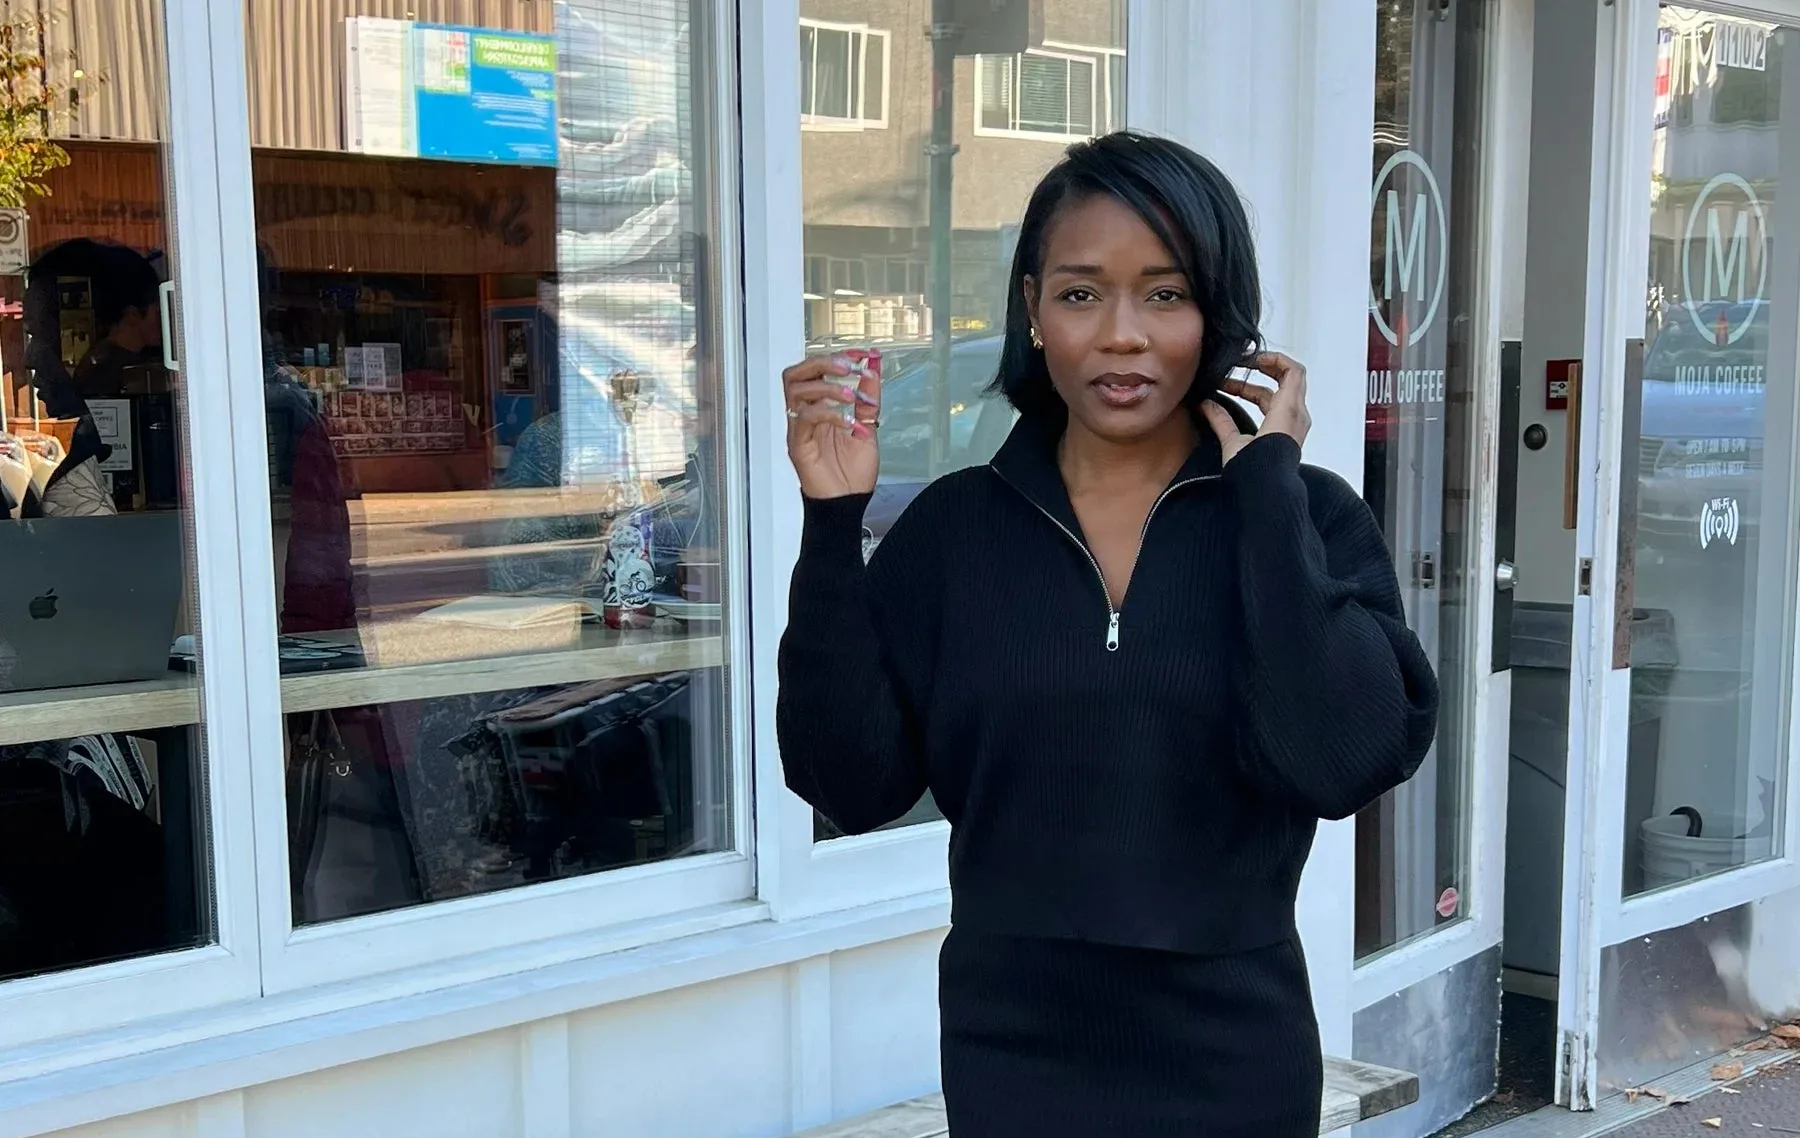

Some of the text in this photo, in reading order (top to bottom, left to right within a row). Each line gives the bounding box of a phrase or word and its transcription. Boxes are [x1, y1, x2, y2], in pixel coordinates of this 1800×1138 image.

[1719, 23, 1765, 68] 1102
[1384, 190, 1427, 301] M
[1703, 208, 1748, 304] M
[1366, 369, 1444, 404] OJA COFFEE
[1674, 365, 1764, 396] MOJA COFFEE
